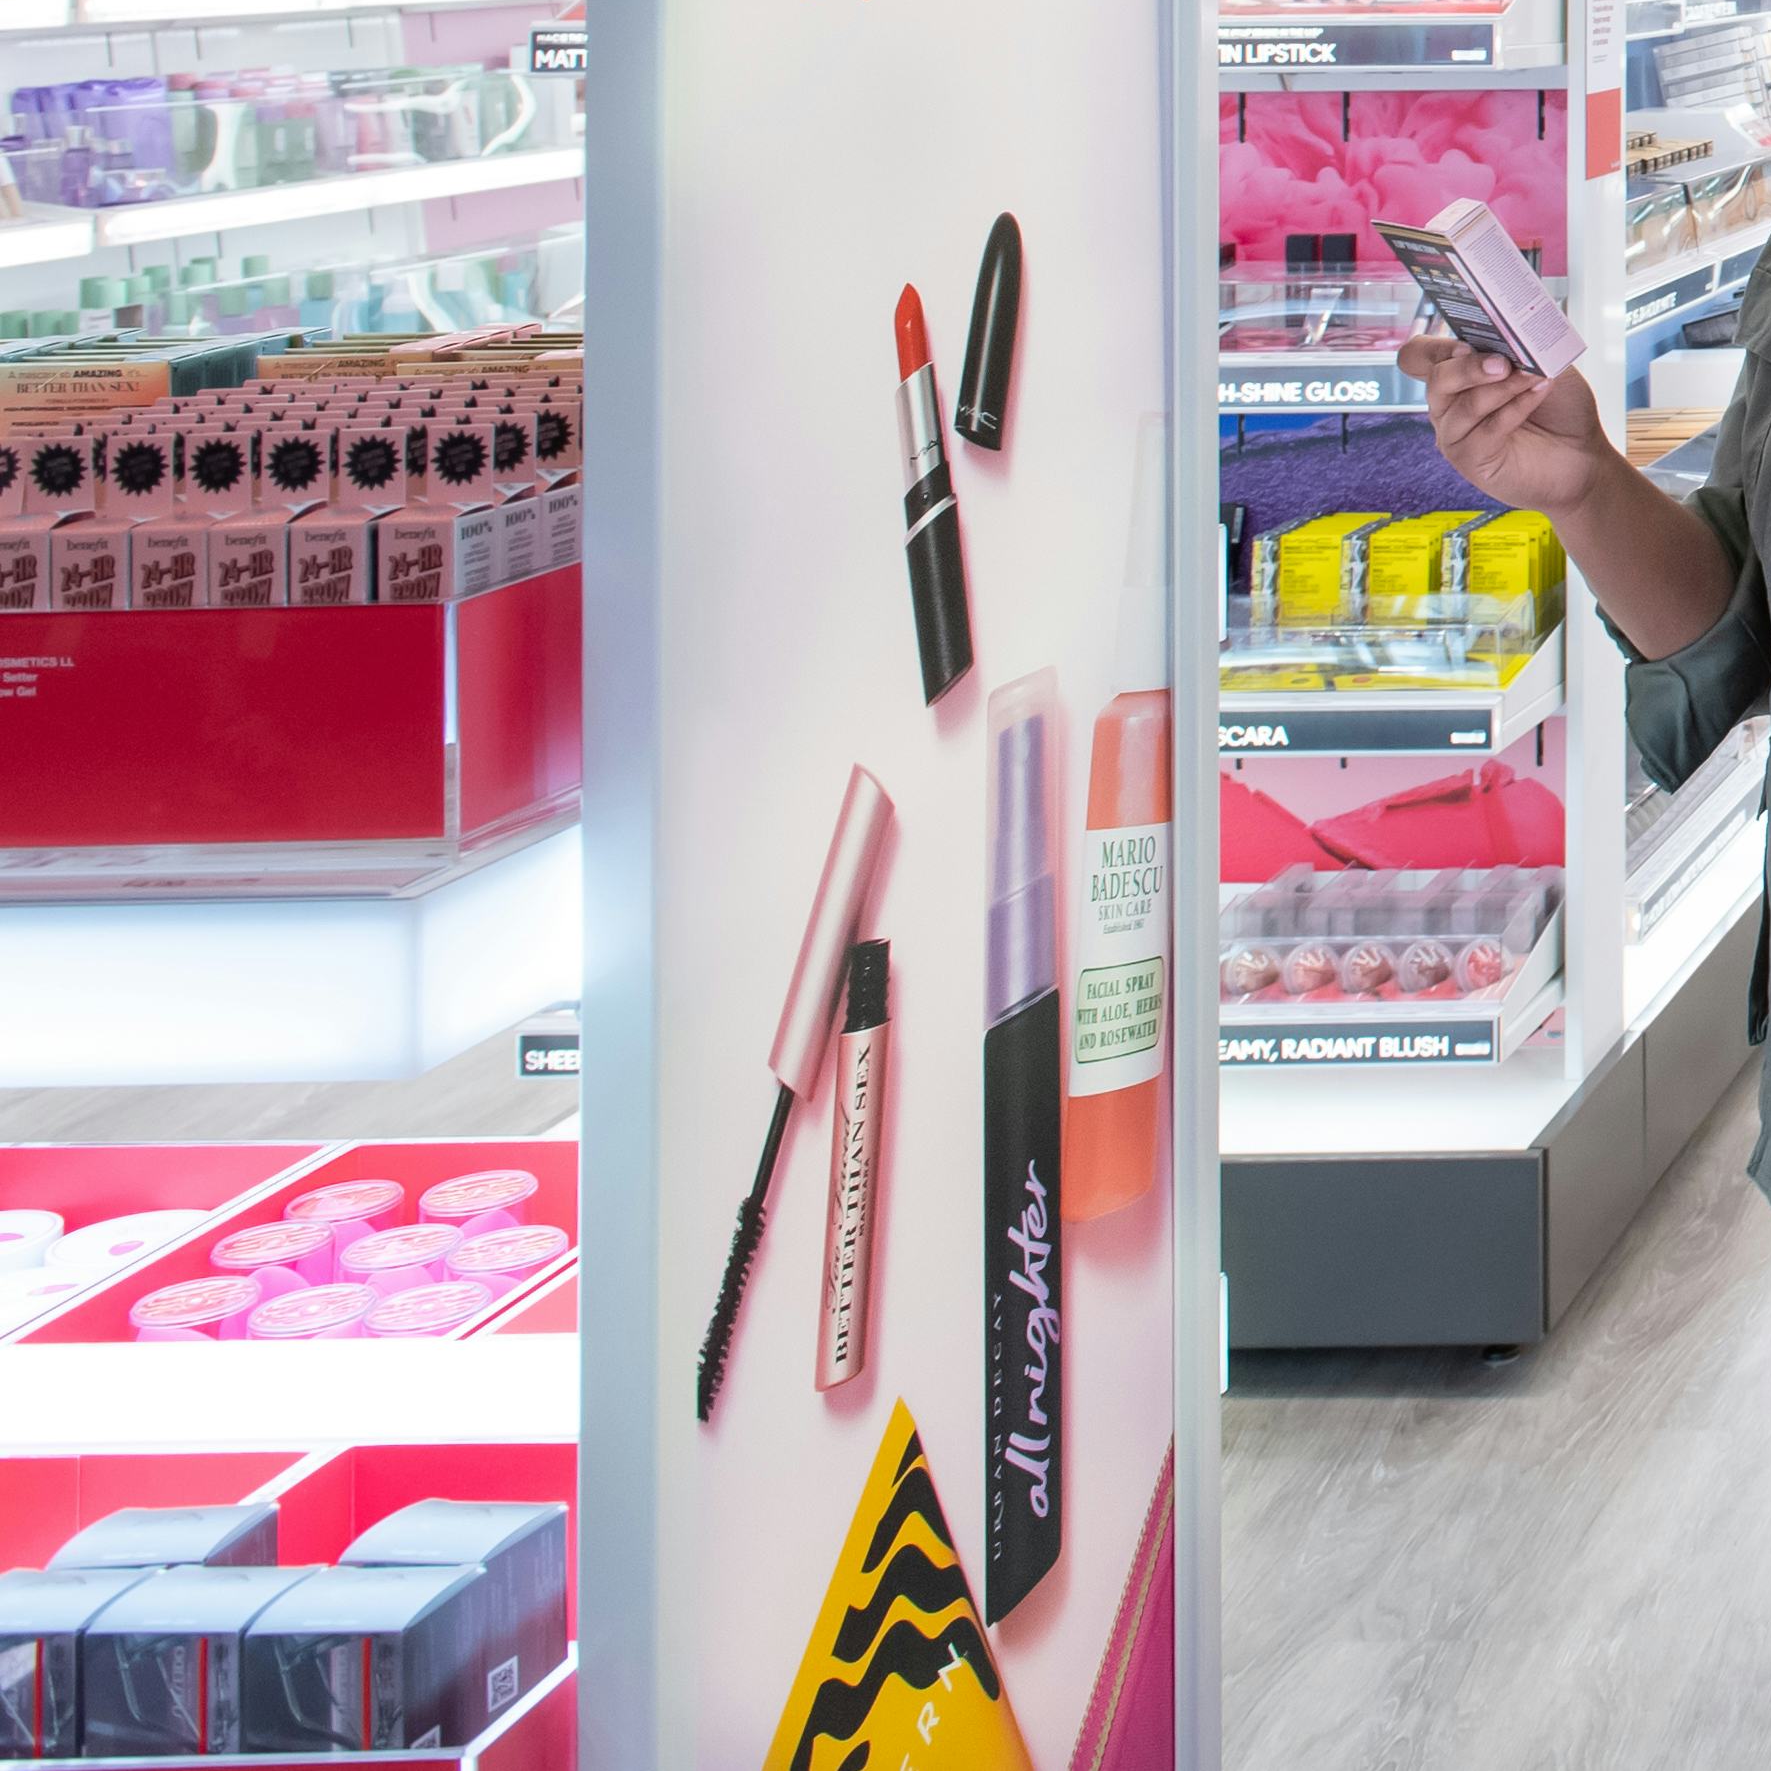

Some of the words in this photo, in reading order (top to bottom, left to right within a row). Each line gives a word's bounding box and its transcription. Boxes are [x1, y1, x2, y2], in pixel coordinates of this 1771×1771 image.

[1218, 43, 1242, 63] IN
[1246, 43, 1337, 63] LIPSTICK
[73, 369, 122, 379] AMAZING
[337, 359, 386, 369] AMAZING
[481, 364, 530, 374] AMAZING
[16, 382, 66, 394] BETTER
[72, 382, 109, 394] THAN
[110, 381, 139, 393] SEX!
[1218, 381, 1302, 403] H-SHINE
[1305, 381, 1380, 401] GLOSS
[460, 521, 494, 541] 100%
[505, 507, 537, 527] 100%
[67, 538, 108, 552] benefit
[147, 536, 189, 549] benefit
[225, 533, 267, 547] benefit
[305, 530, 347, 544] benefit
[395, 527, 436, 542] benefit
[61, 554, 115, 593] 24-HR
[141, 552, 196, 590] 24-HR
[219, 550, 274, 588] 24-HR
[299, 546, 353, 585] 24-HR
[389, 543, 443, 583] 24-HR
[16, 686, 37, 697] Gel
[1102, 836, 1156, 868] MARIO
[1091, 866, 1164, 902] BADESCU
[1099, 903, 1124, 921] SKIN
[1126, 899, 1152, 919] CARE
[1087, 981, 1121, 1000] FACIAL
[1126, 972, 1156, 995] SPRAY
[1078, 1007, 1098, 1024] WITH
[1101, 1001, 1133, 1022] ALOE,
[1136, 993, 1162, 1016] HERBS
[1079, 1032, 1097, 1050] AND
[1100, 1019, 1158, 1047] ROSEWATER
[1218, 1039, 1279, 1062] EAMY,
[1281, 1037, 1377, 1059] RADIANT
[1379, 1036, 1450, 1058] BLUSH
[854, 1042, 872, 1111] SEX
[846, 1119, 866, 1219] THAN
[858, 1157, 871, 1237] MASCARA
[835, 1225, 858, 1365] BETTER
[1007, 1159, 1061, 1426] nighter
[992, 1292, 1003, 1417] DECAY
[1005, 1431, 1051, 1518] all
[992, 1434, 1005, 1562] URBAN
